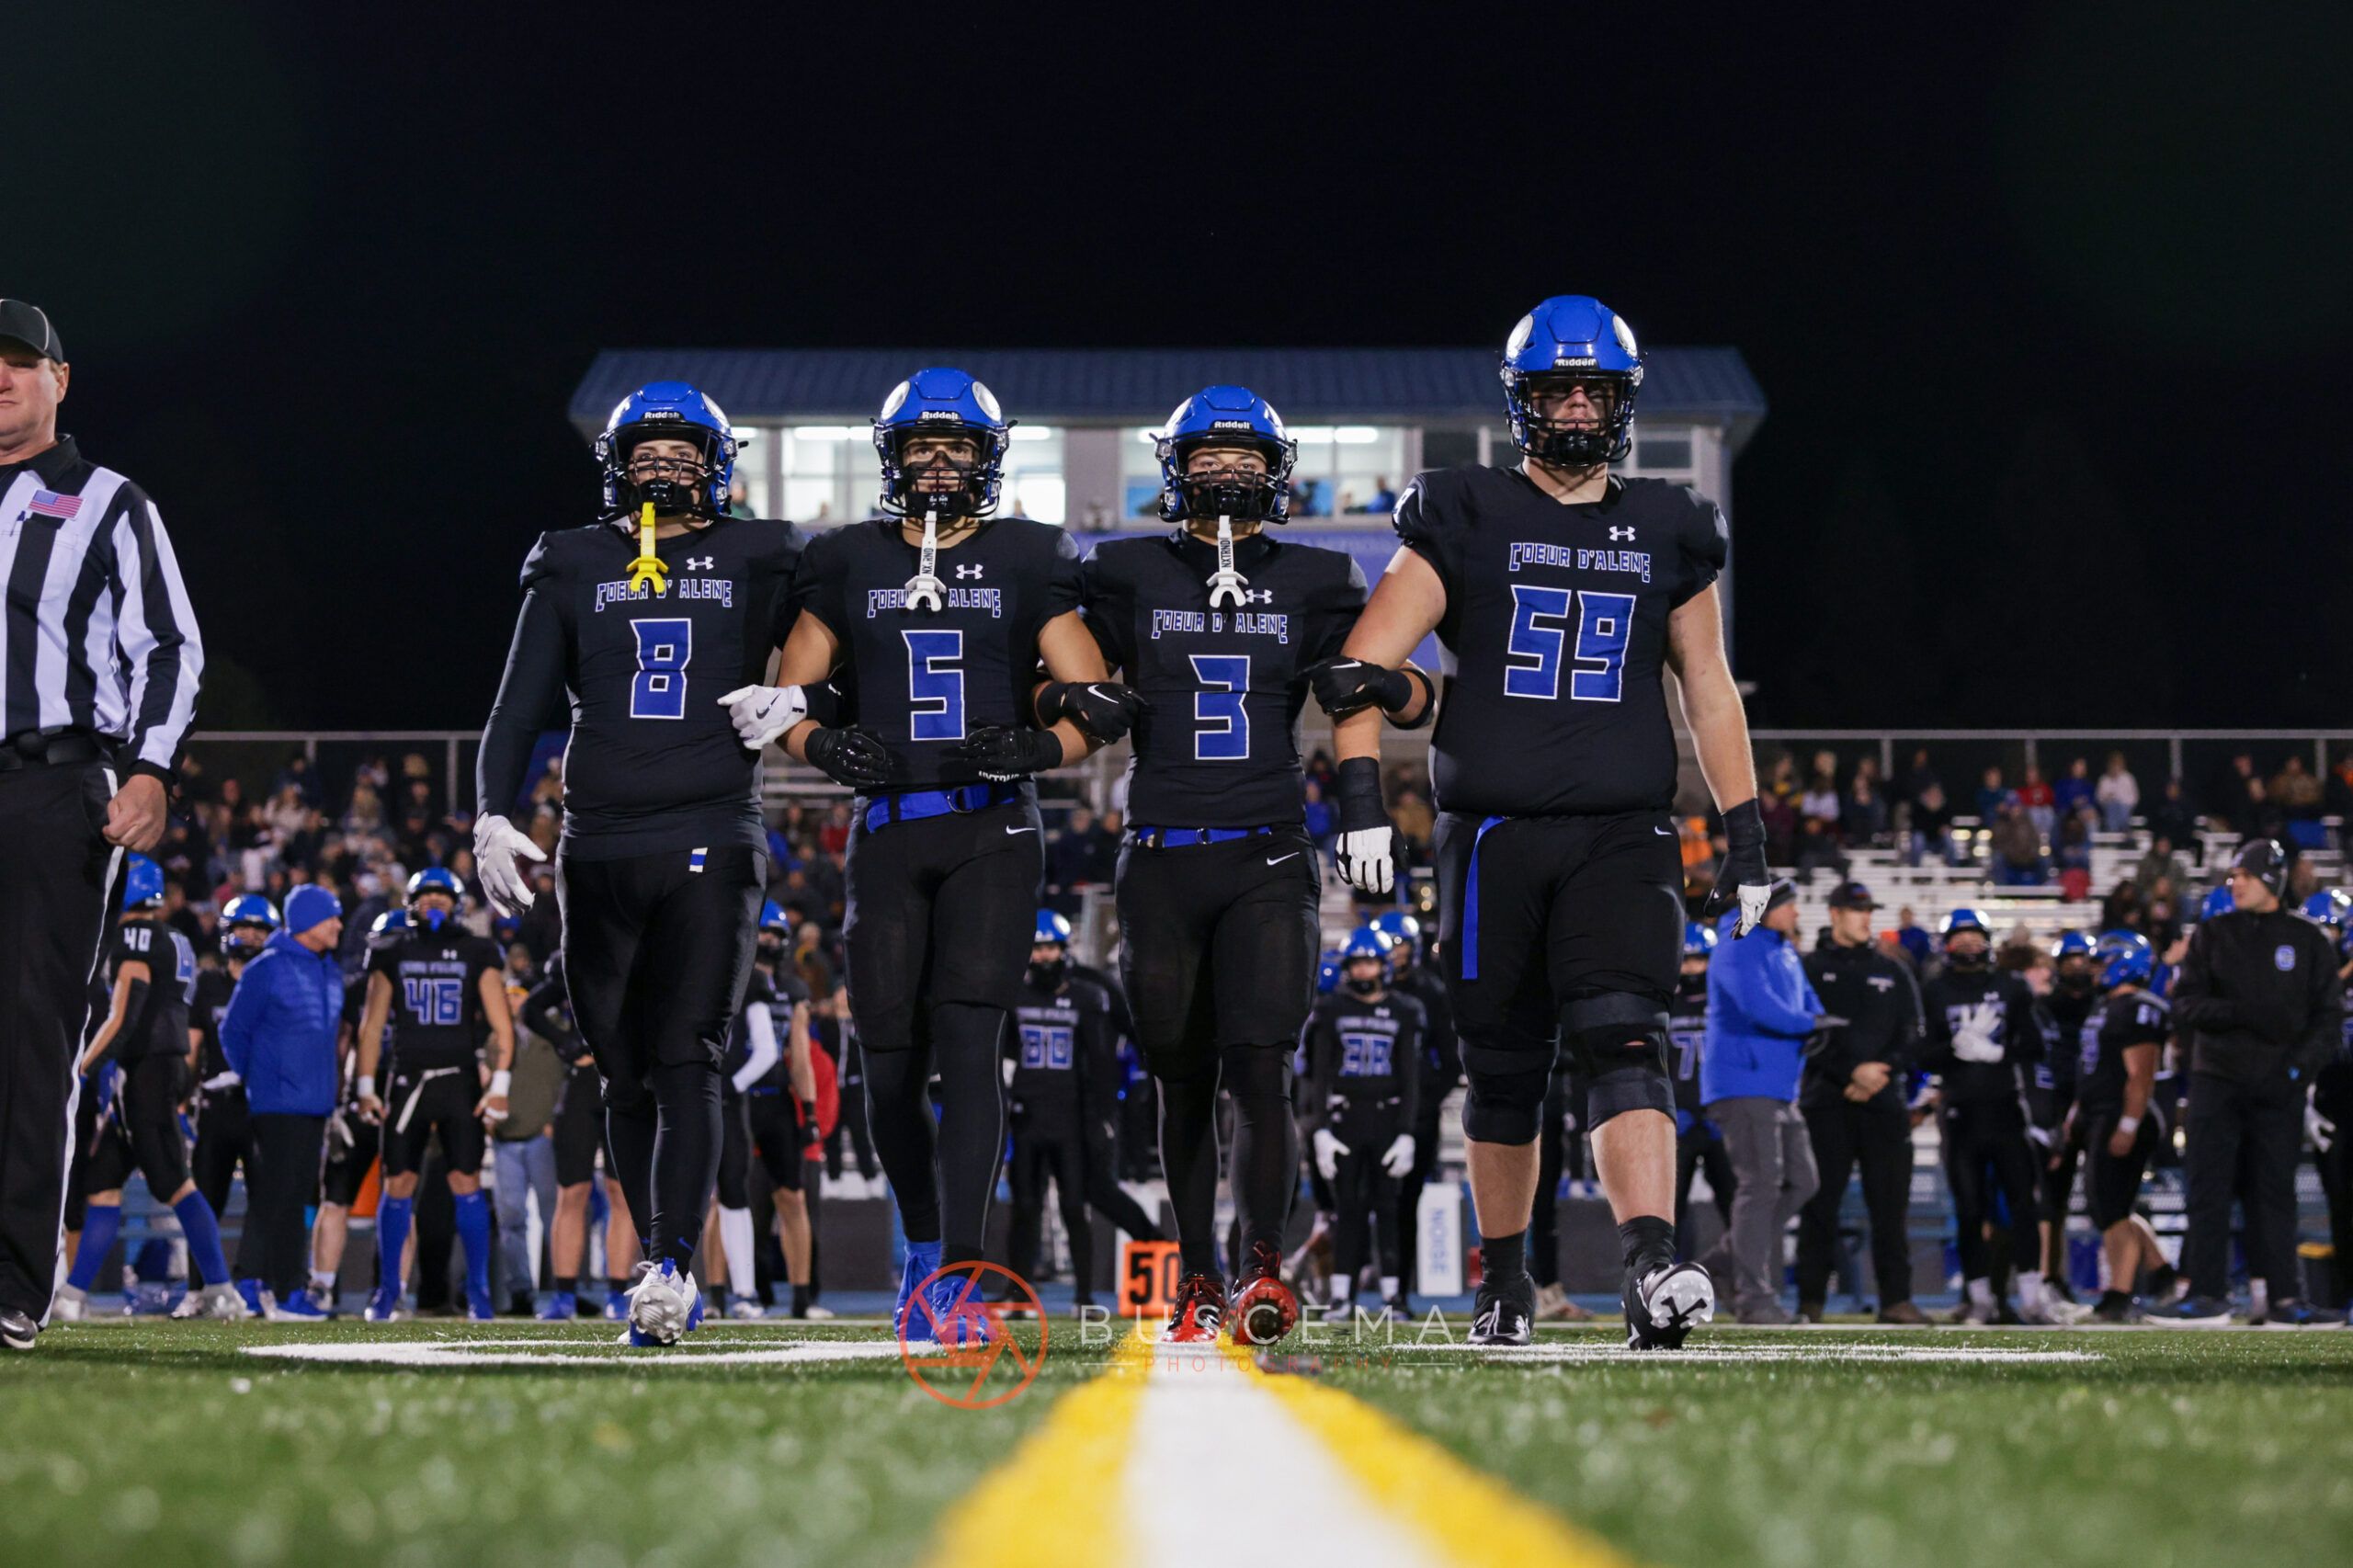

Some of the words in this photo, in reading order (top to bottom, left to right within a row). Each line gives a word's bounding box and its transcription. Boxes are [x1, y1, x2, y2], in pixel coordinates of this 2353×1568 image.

[922, 411, 959, 420] Riddell
[1214, 421, 1250, 429] Riddell
[922, 548, 934, 574] NXRND
[1509, 543, 1570, 571] COEUR
[1577, 549, 1651, 583] D'ALENE
[679, 578, 732, 608] ALENE
[867, 589, 917, 618] COEU
[949, 588, 1001, 618] ALENE
[1151, 609, 1204, 639] COEUR
[1504, 585, 1636, 702] 59
[630, 618, 691, 720] 8
[901, 630, 965, 741] 5
[1188, 654, 1250, 760] 3
[123, 927, 152, 952] 40
[403, 978, 462, 1025] 46
[1130, 1252, 1181, 1304] 50
